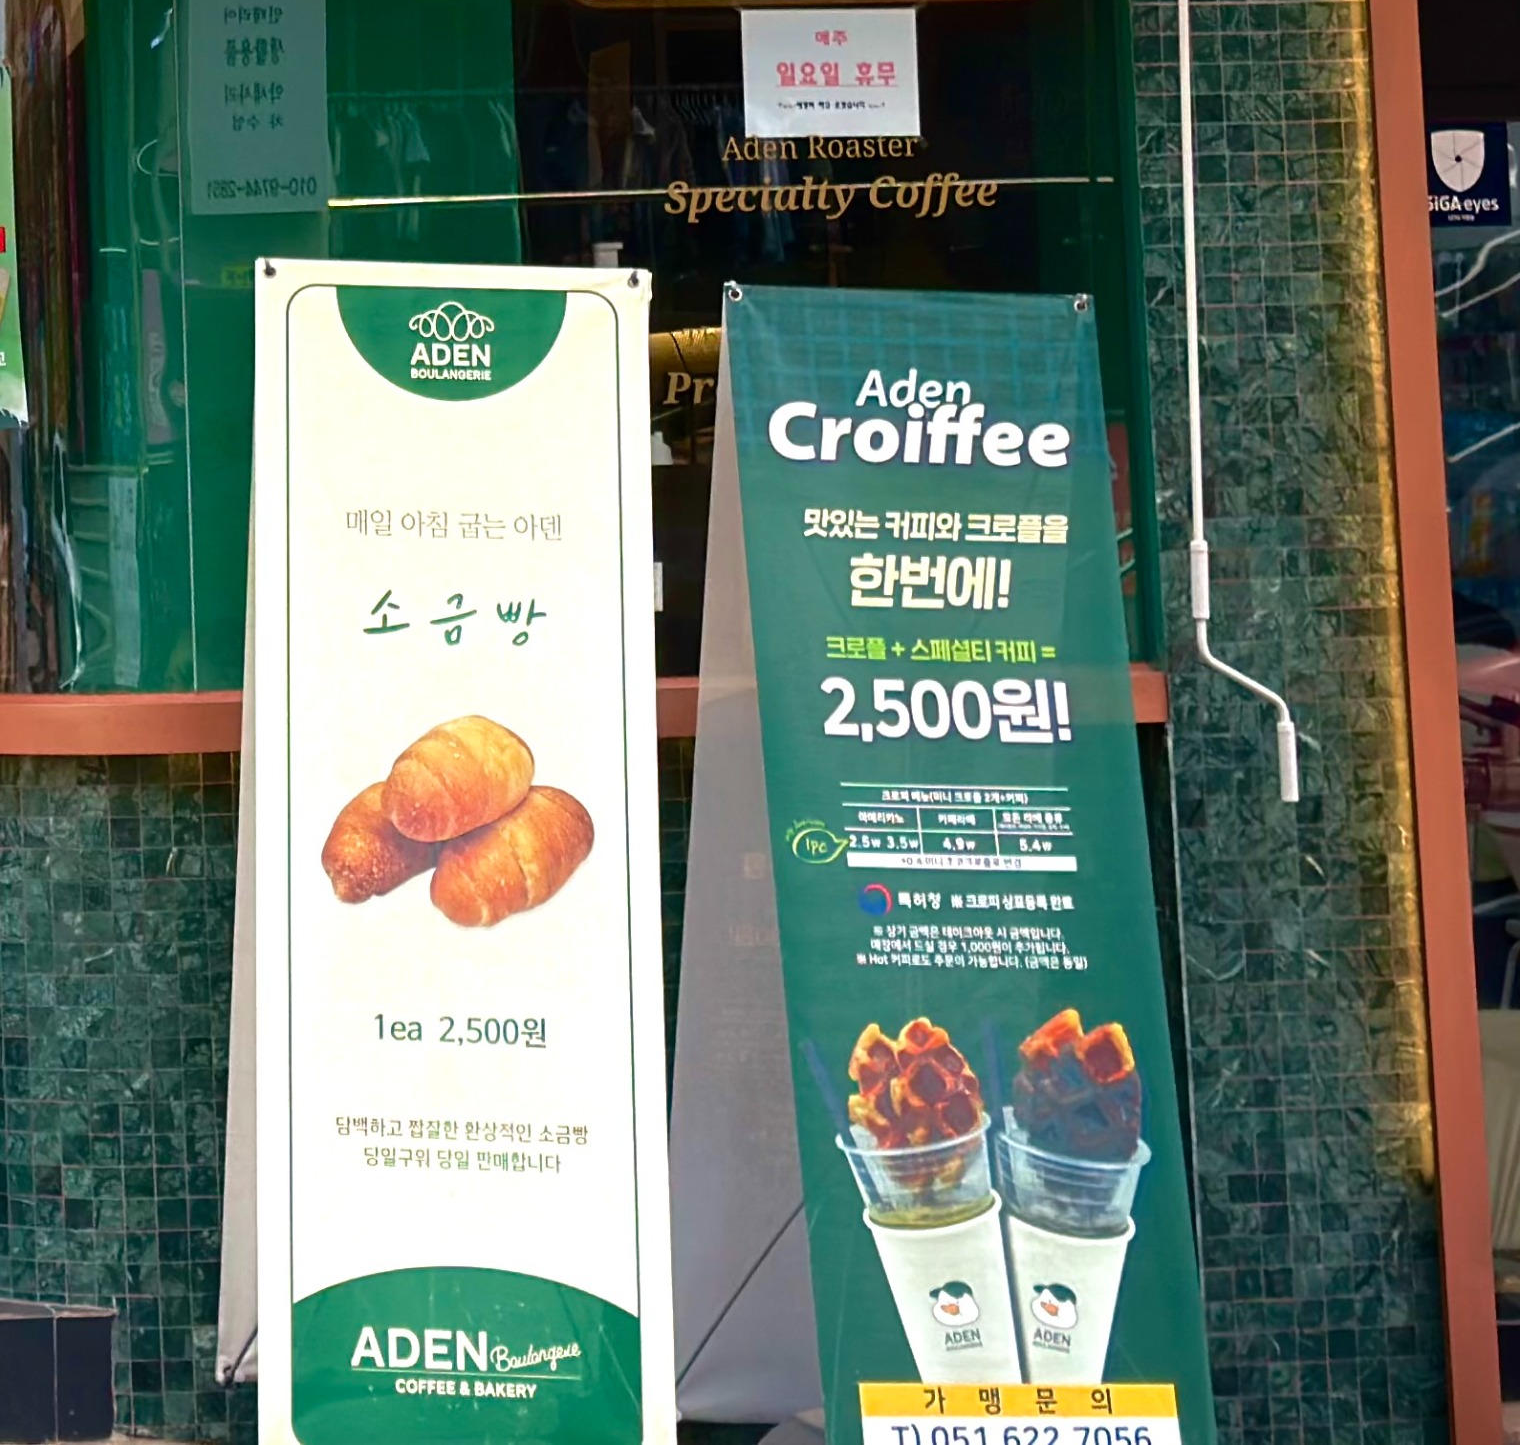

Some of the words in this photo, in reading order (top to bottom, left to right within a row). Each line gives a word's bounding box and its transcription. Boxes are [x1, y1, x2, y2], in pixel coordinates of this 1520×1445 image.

[815, 30, 847, 46] 매주
[776, 62, 839, 86] 일요일
[855, 62, 896, 86] 휴무
[722, 136, 798, 161] Aden
[807, 135, 919, 159] Roaster
[664, 175, 856, 223] Specialty
[868, 172, 999, 219] Coffee
[1463, 198, 1499, 214] eyes
[410, 343, 492, 368] ADEN
[410, 368, 492, 381] BOULANGERIE
[855, 368, 971, 408] Aden
[768, 401, 1070, 468] Croiffee
[346, 509, 392, 537] 매일
[400, 511, 449, 539] 아침
[459, 512, 505, 540] 굽는
[513, 514, 562, 542] 아덴
[804, 508, 880, 540] 맛있는
[884, 511, 962, 543] 커피와
[965, 514, 1069, 544] 크로플을
[850, 553, 1011, 610] 한번에!
[826, 636, 886, 660] 크로플
[911, 639, 992, 662] 스페셜티
[995, 640, 1037, 663] 커피
[820, 676, 1072, 744] 2,500원!
[898, 891, 941, 909] 특허청
[1002, 894, 1048, 911] 상표등록
[886, 925, 907, 938] 상기
[909, 925, 939, 939] 금액은
[942, 926, 994, 940] 테이크아웃
[996, 927, 1007, 939] 시
[937, 941, 959, 954] 경우
[869, 955, 889, 966] Hot
[891, 955, 931, 967] 커피로도
[934, 956, 965, 968] 주문이
[374, 1013, 422, 1043] 1ea
[439, 1016, 547, 1049] 2,500원
[335, 1116, 403, 1138] 담백하고
[409, 1120, 460, 1141] 짭짤한
[464, 1122, 533, 1143] 환상적인
[538, 1125, 589, 1146] 소금빵
[364, 1147, 431, 1169] 당일구워
[437, 1149, 470, 1171] 당일
[476, 1152, 562, 1174] 판매합니다
[351, 1326, 487, 1372] ADEN
[944, 1328, 980, 1345] ADEN
[1033, 1327, 1071, 1346] ADEN
[395, 1379, 456, 1397] COFFEE
[459, 1382, 471, 1397] &
[474, 1382, 537, 1399] BAKERY
